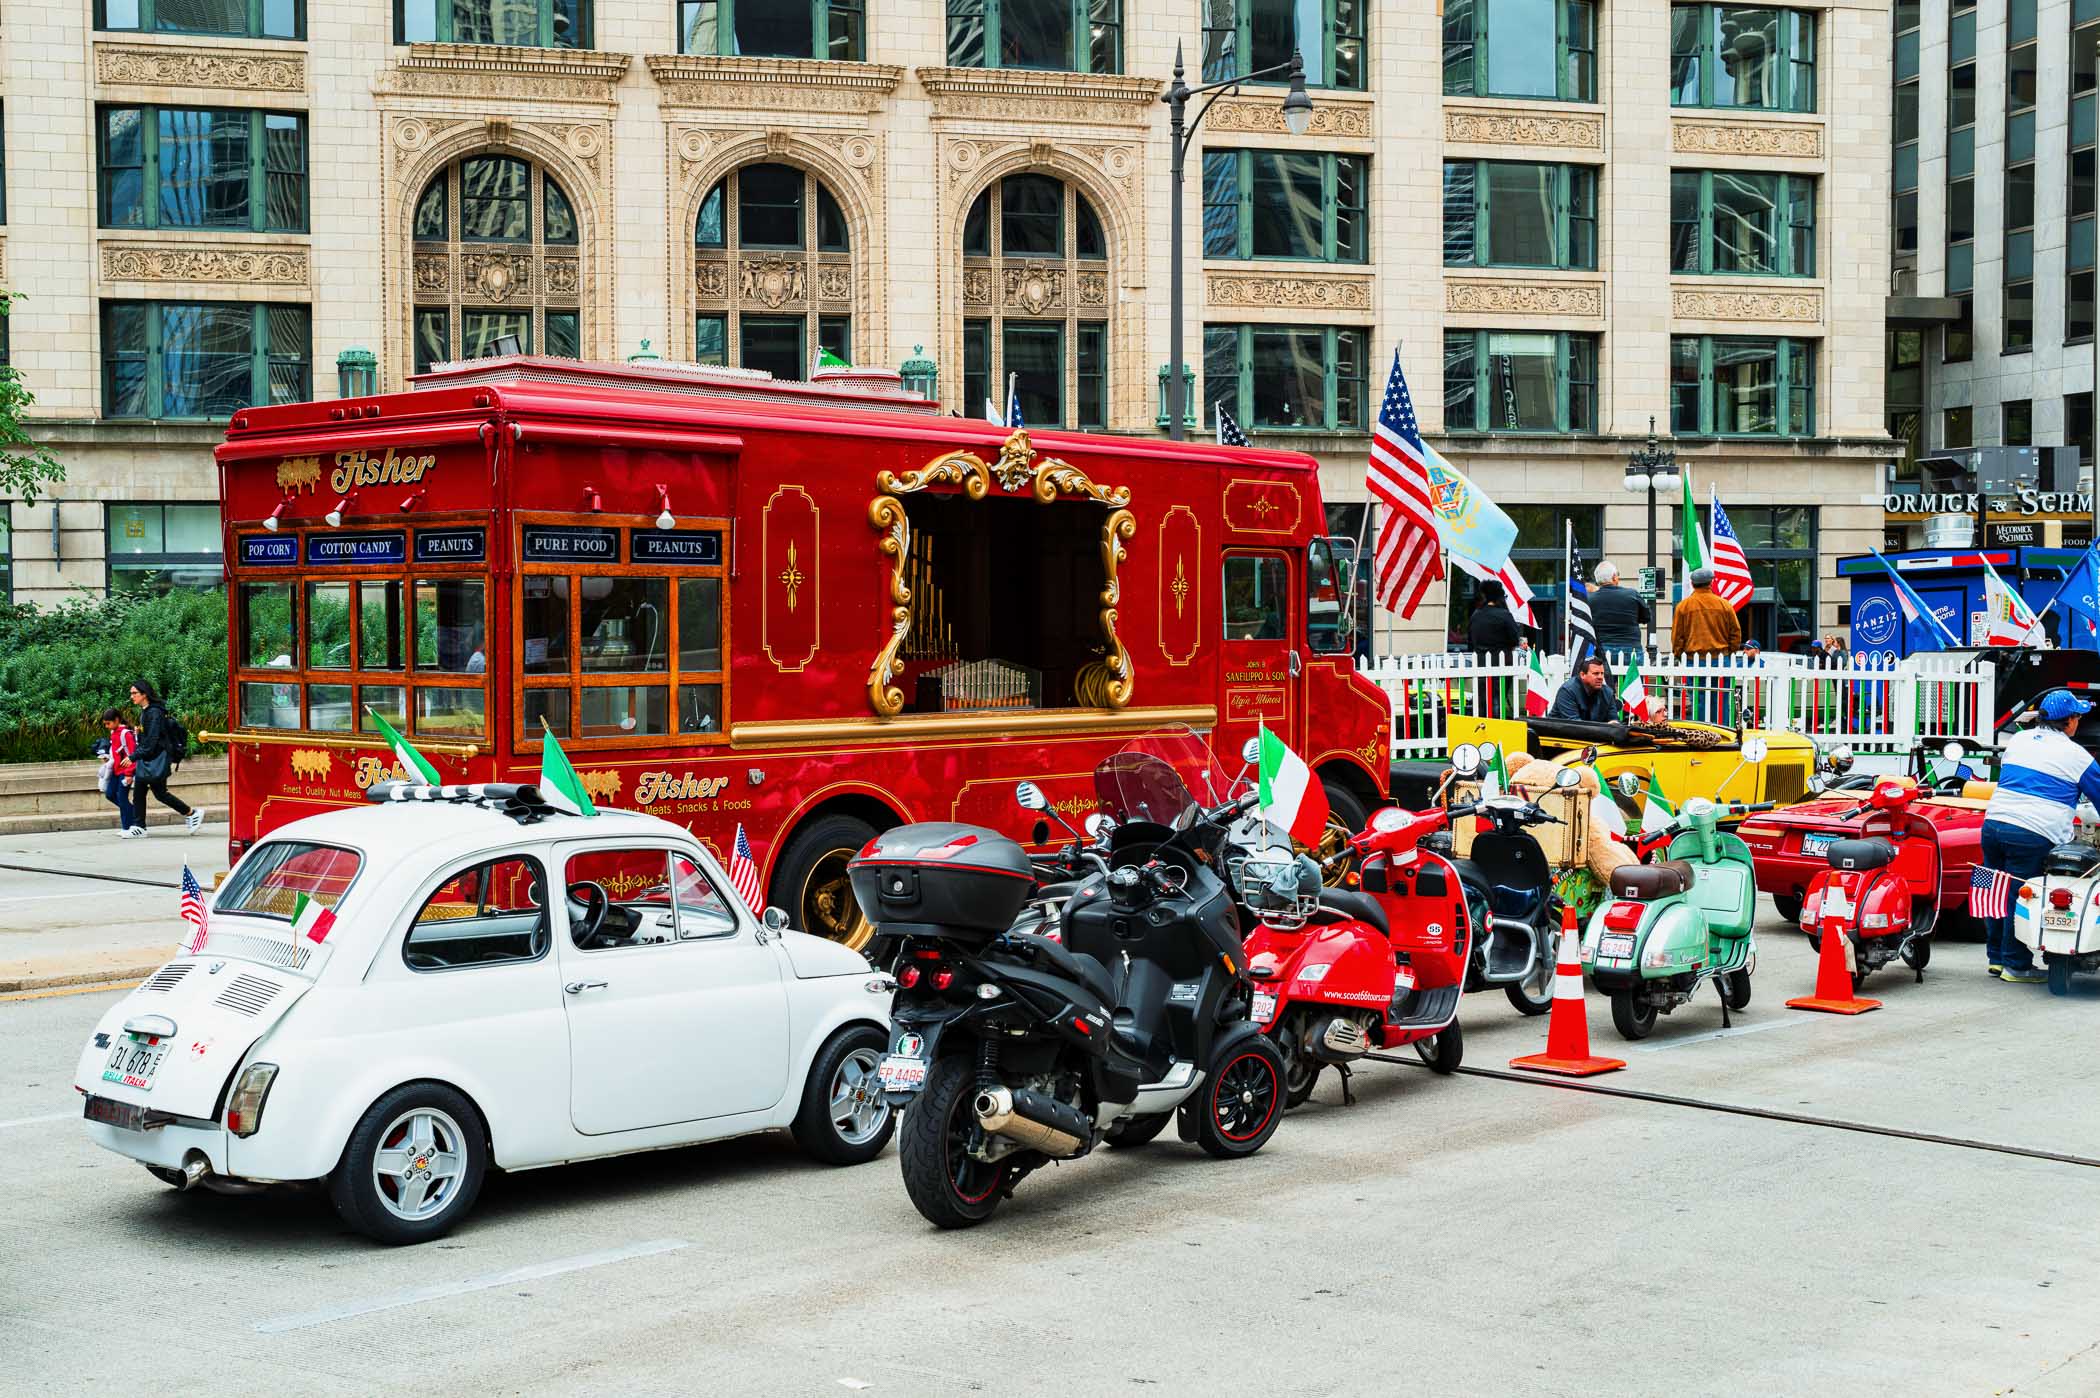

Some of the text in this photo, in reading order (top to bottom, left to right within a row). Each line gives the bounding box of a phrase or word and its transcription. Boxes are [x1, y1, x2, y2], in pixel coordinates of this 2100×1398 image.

[331, 447, 436, 494] Fisher
[1884, 493, 1979, 513] ORMICK
[2017, 489, 2093, 515] SCHM
[248, 543, 291, 556] POP CORN
[320, 541, 392, 555] COTTON CANDY
[428, 538, 474, 552] PEANUTS
[535, 537, 608, 552] PURE FOOD
[648, 540, 703, 554] PEANUTS
[2062, 538, 2086, 546] FOOD
[1226, 672, 1264, 681] SANFILIPPO
[1272, 672, 1286, 680] SON
[283, 784, 301, 794] Finest
[305, 786, 327, 799] Quality
[329, 789, 341, 798] Nut
[635, 771, 729, 805] Fisher
[677, 802, 708, 814] Snacks
[712, 801, 719, 812] &
[723, 799, 752, 811] Foods
[111, 1046, 152, 1075] 31 678
[103, 1070, 147, 1087] BELLA ITALIA
